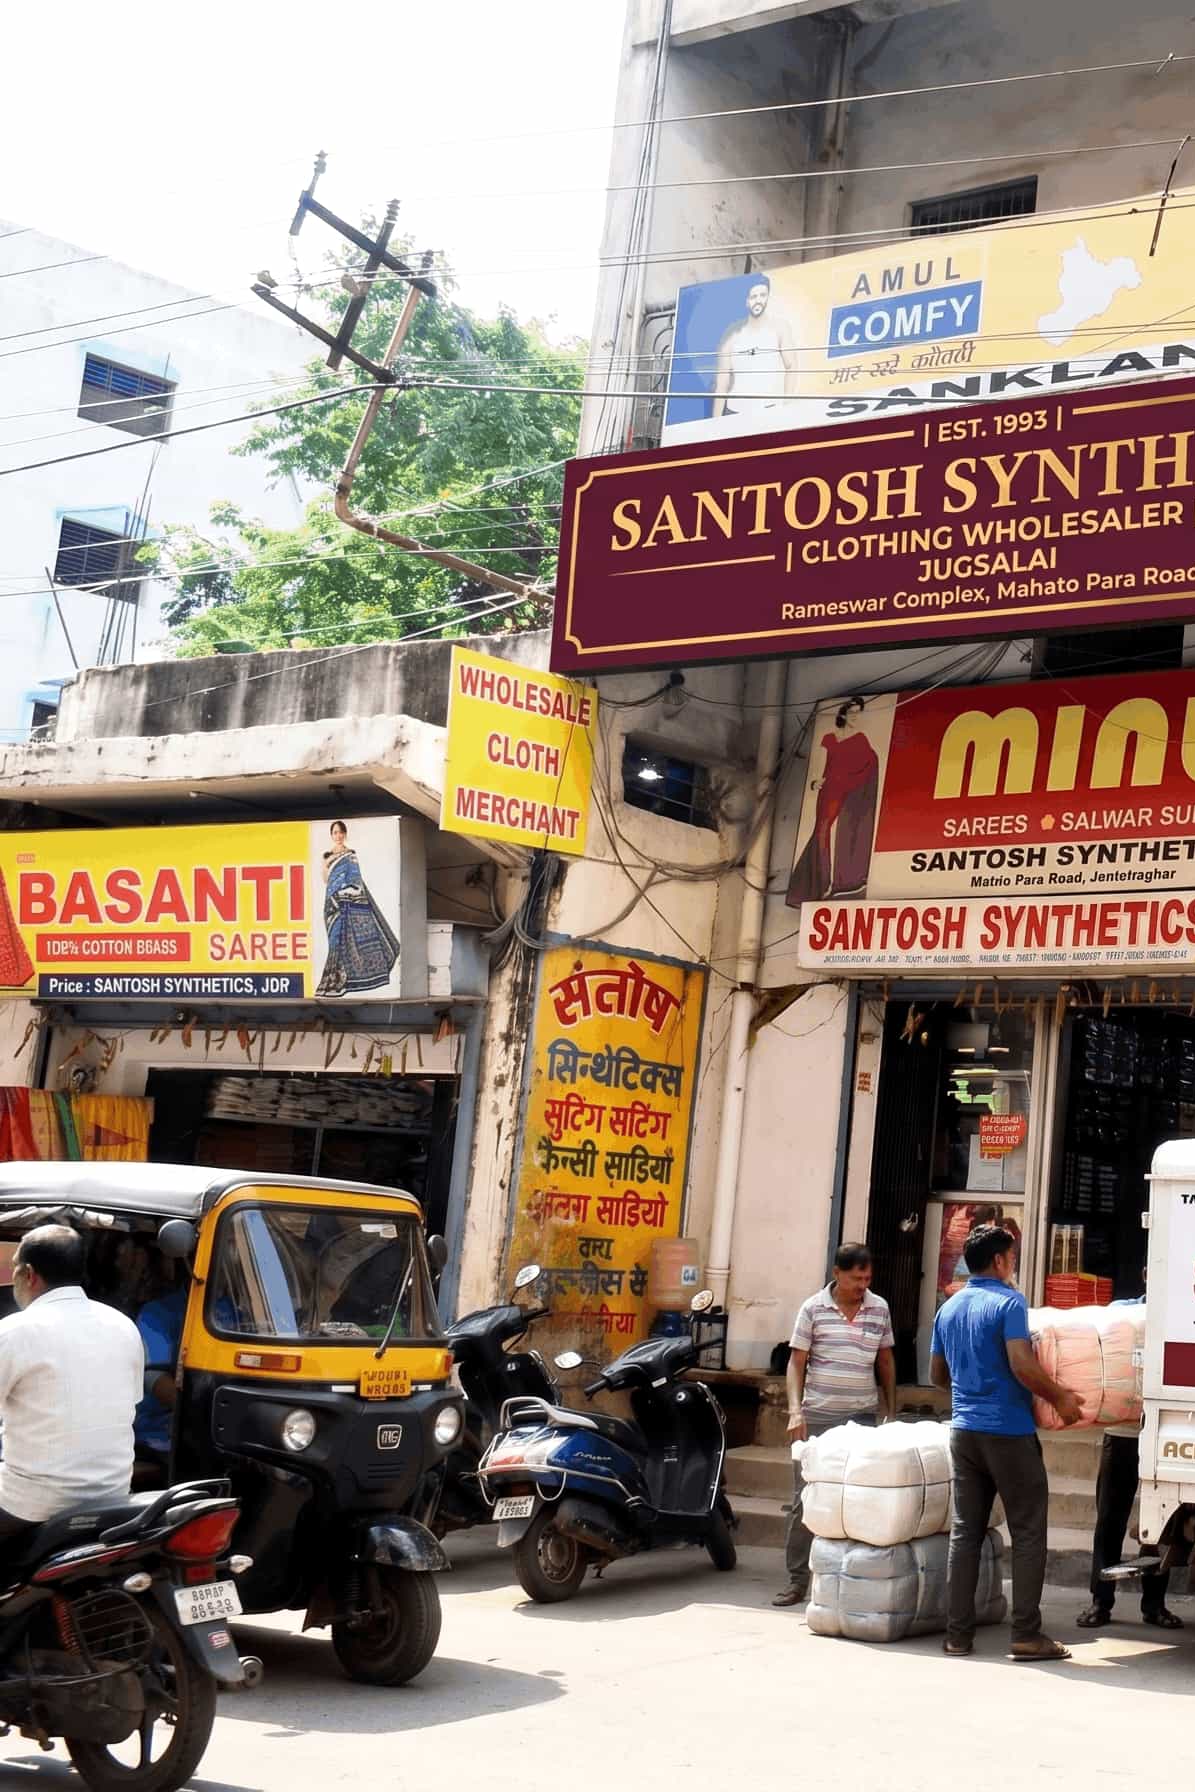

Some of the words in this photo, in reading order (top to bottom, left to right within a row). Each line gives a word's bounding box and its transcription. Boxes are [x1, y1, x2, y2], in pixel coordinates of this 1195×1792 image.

[851, 257, 961, 299] AMUL
[837, 294, 974, 346] COMFY
[938, 420, 986, 443] EST.
[994, 410, 1048, 435] 1993
[610, 463, 924, 553] SANTOSH
[801, 527, 953, 565] CLOTHING
[961, 501, 1184, 548] WHOLESALER
[917, 547, 1058, 583] JUGSALAI
[781, 595, 887, 621] Rameswar
[893, 583, 991, 611] Complex,
[997, 573, 1079, 600] Mahato
[1086, 570, 1136, 592] Para
[460, 664, 592, 727] WHOLESALE
[487, 733, 560, 777] CLOTH
[456, 787, 580, 839] MERCHANT
[943, 814, 1028, 838] SAREES
[1060, 808, 1152, 832] SALWAR
[910, 846, 1047, 873] SANTOSH
[970, 873, 1011, 888] Matrio
[1015, 873, 1044, 887] Para
[1048, 869, 1086, 888] Road,
[19, 865, 305, 924] BASANTI
[82, 938, 132, 955] COTTON
[210, 932, 308, 961] SAREE
[808, 906, 968, 951] SANTOSH
[49, 978, 83, 993] Price
[94, 977, 160, 993] SANTOSH
[164, 976, 258, 995] SYNTHETICS,
[548, 960, 682, 1035] संतोष
[547, 1038, 684, 1098] सिन्थेटिक्स
